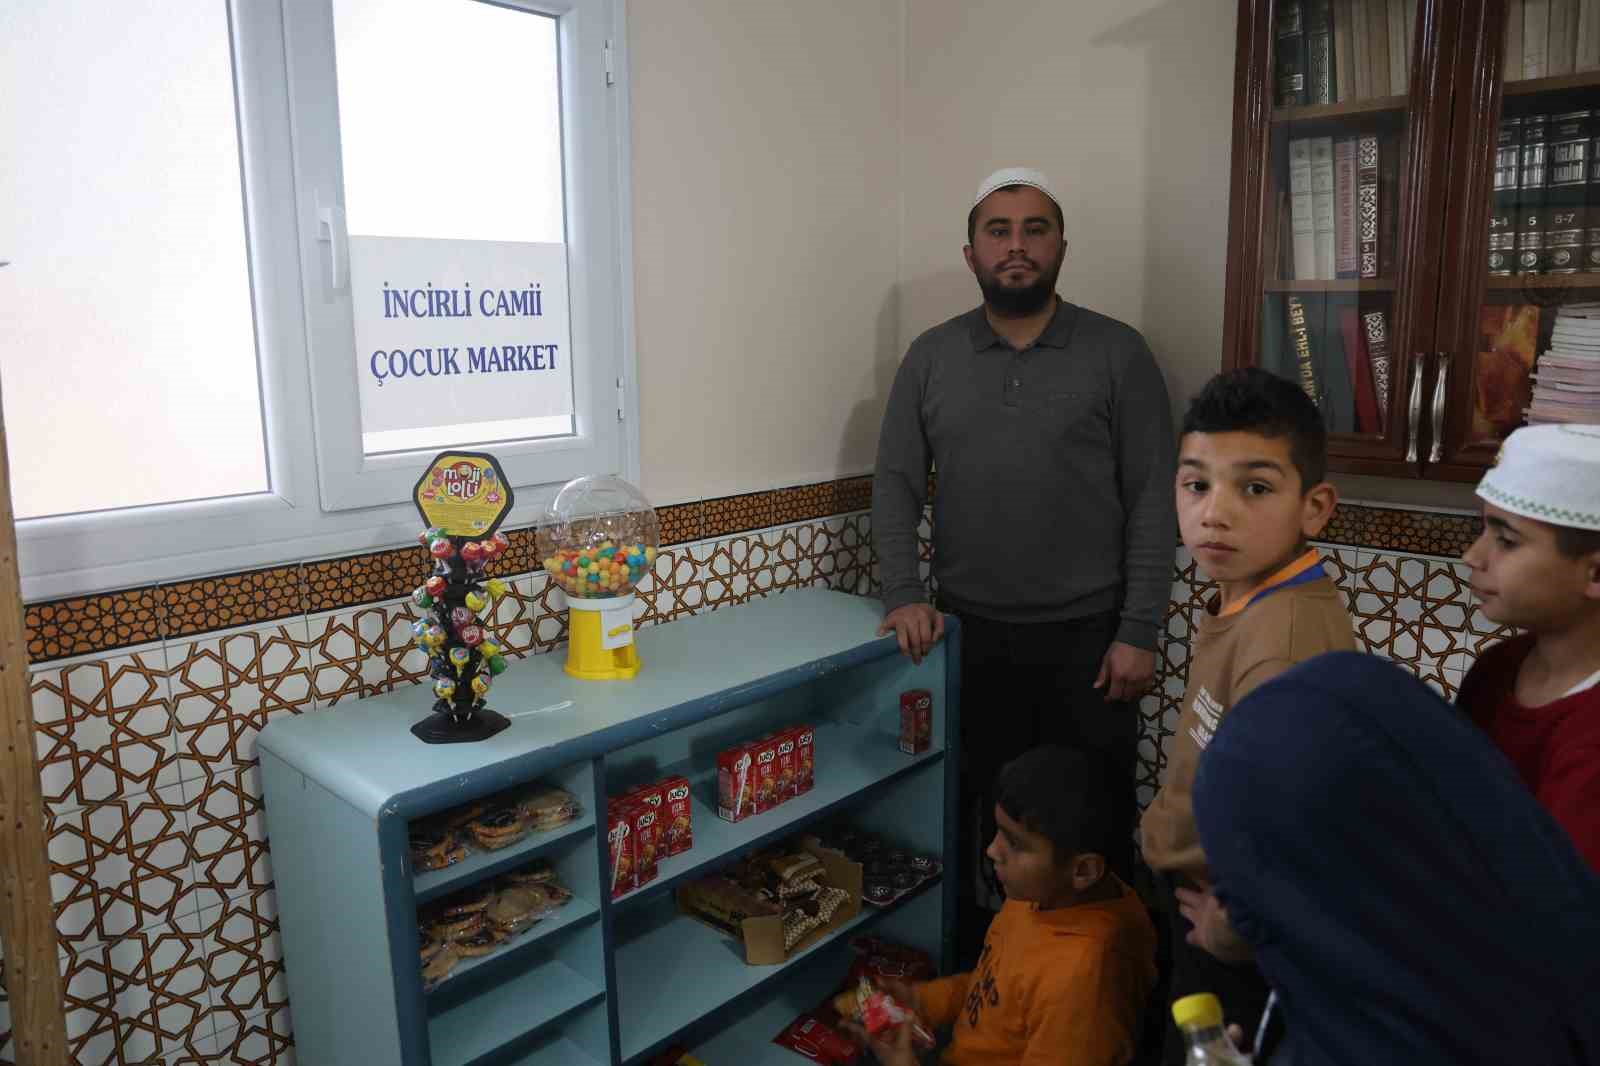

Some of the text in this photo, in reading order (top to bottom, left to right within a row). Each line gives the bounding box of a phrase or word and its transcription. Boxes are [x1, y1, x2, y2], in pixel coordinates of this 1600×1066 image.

[383, 281, 543, 318] İNCİRLİ CAMİİ
[370, 344, 558, 387] ÇOCUK MARKET
